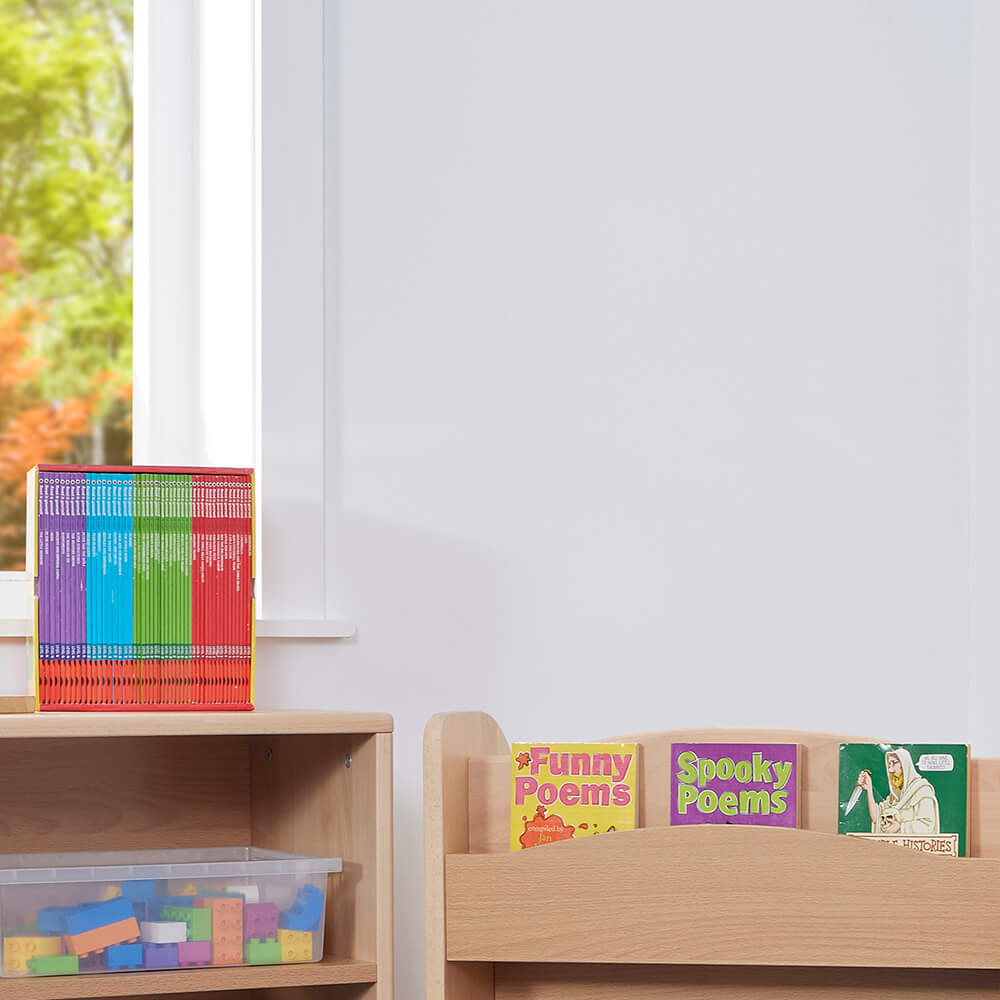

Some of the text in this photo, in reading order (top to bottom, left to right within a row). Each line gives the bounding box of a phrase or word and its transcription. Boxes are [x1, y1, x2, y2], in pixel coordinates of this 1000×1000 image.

[530, 747, 632, 782] Funny
[677, 751, 793, 790] Spooky
[515, 776, 631, 806] Poems
[678, 783, 788, 816] Poems
[903, 839, 952, 853] HISTORIES
